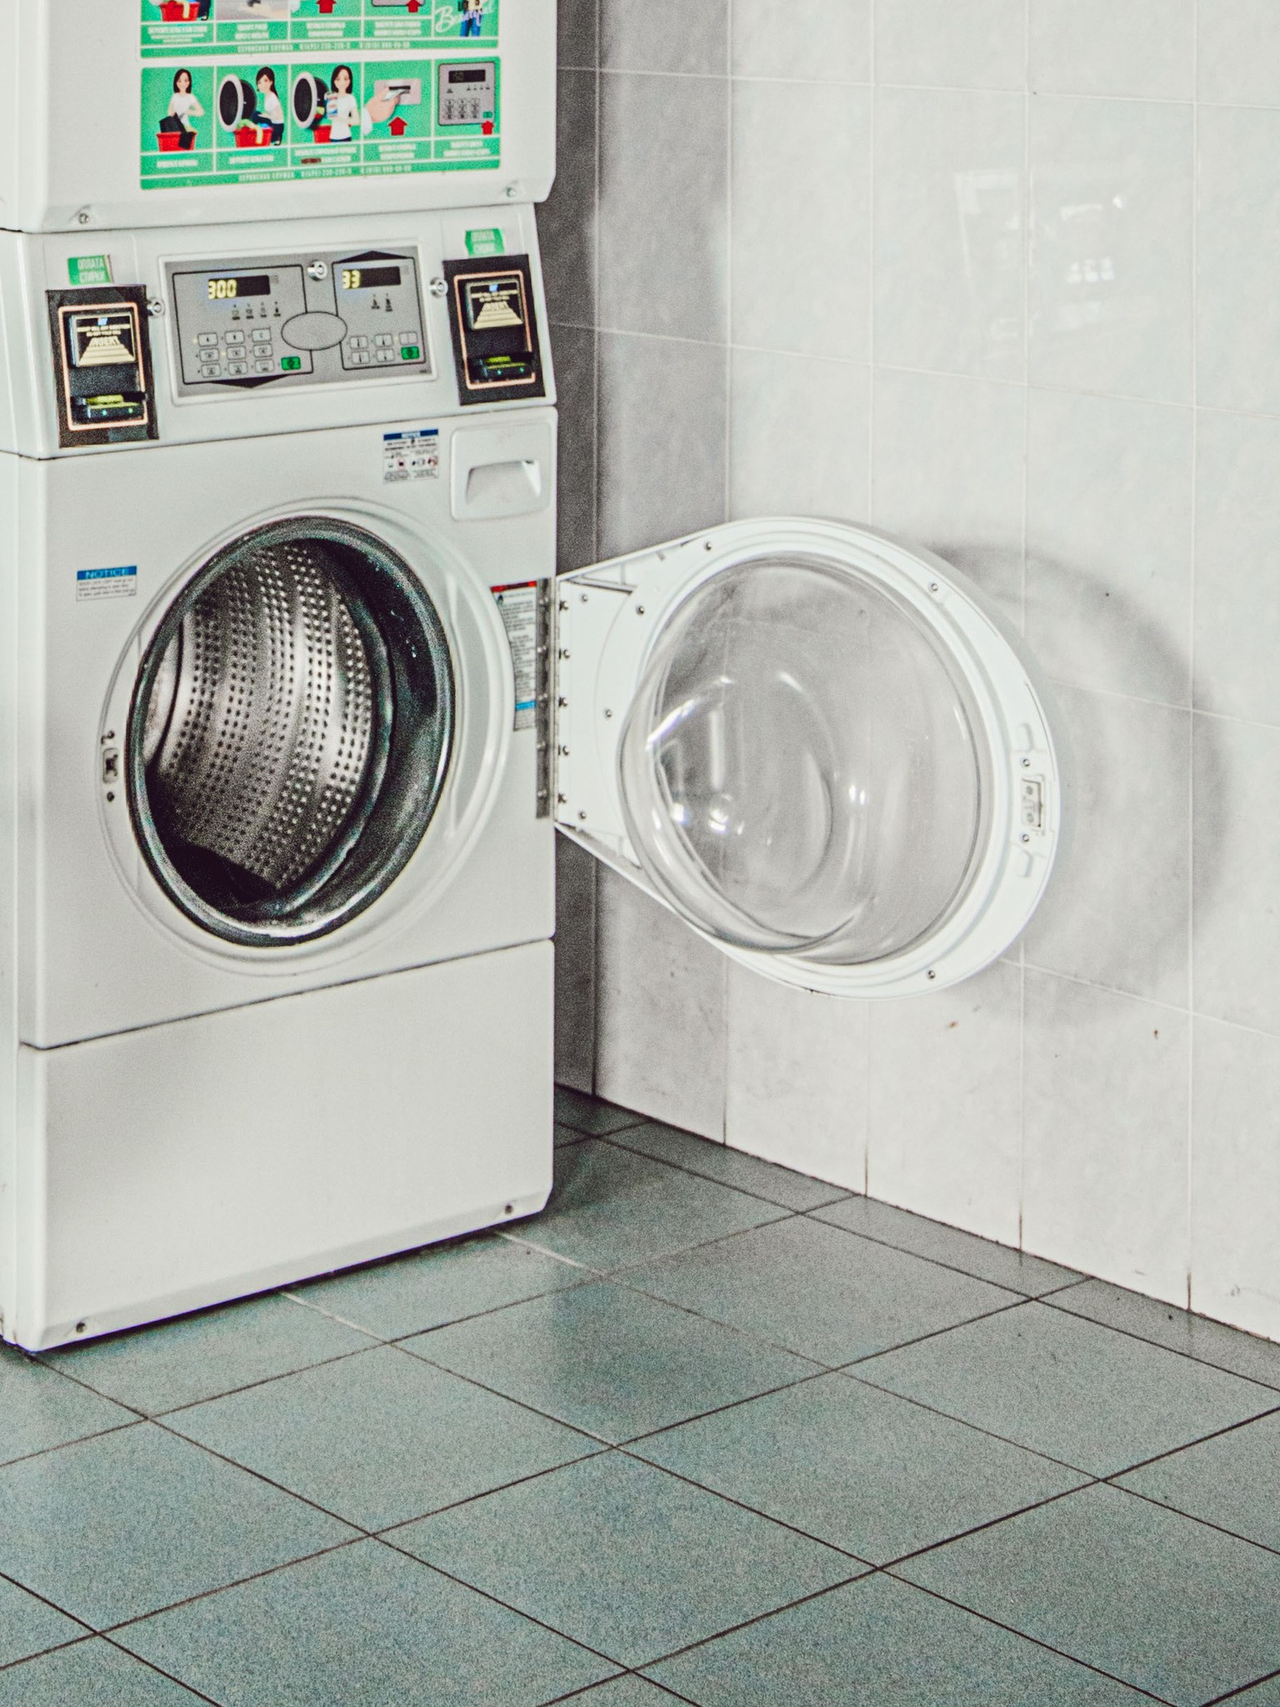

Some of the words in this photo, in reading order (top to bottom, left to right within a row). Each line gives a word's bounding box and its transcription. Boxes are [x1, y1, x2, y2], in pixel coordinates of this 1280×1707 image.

[78, 257, 105, 270] ОПЛАТА
[342, 269, 361, 289] 33
[208, 279, 237, 299] 300
[85, 567, 129, 579] NOTICE
